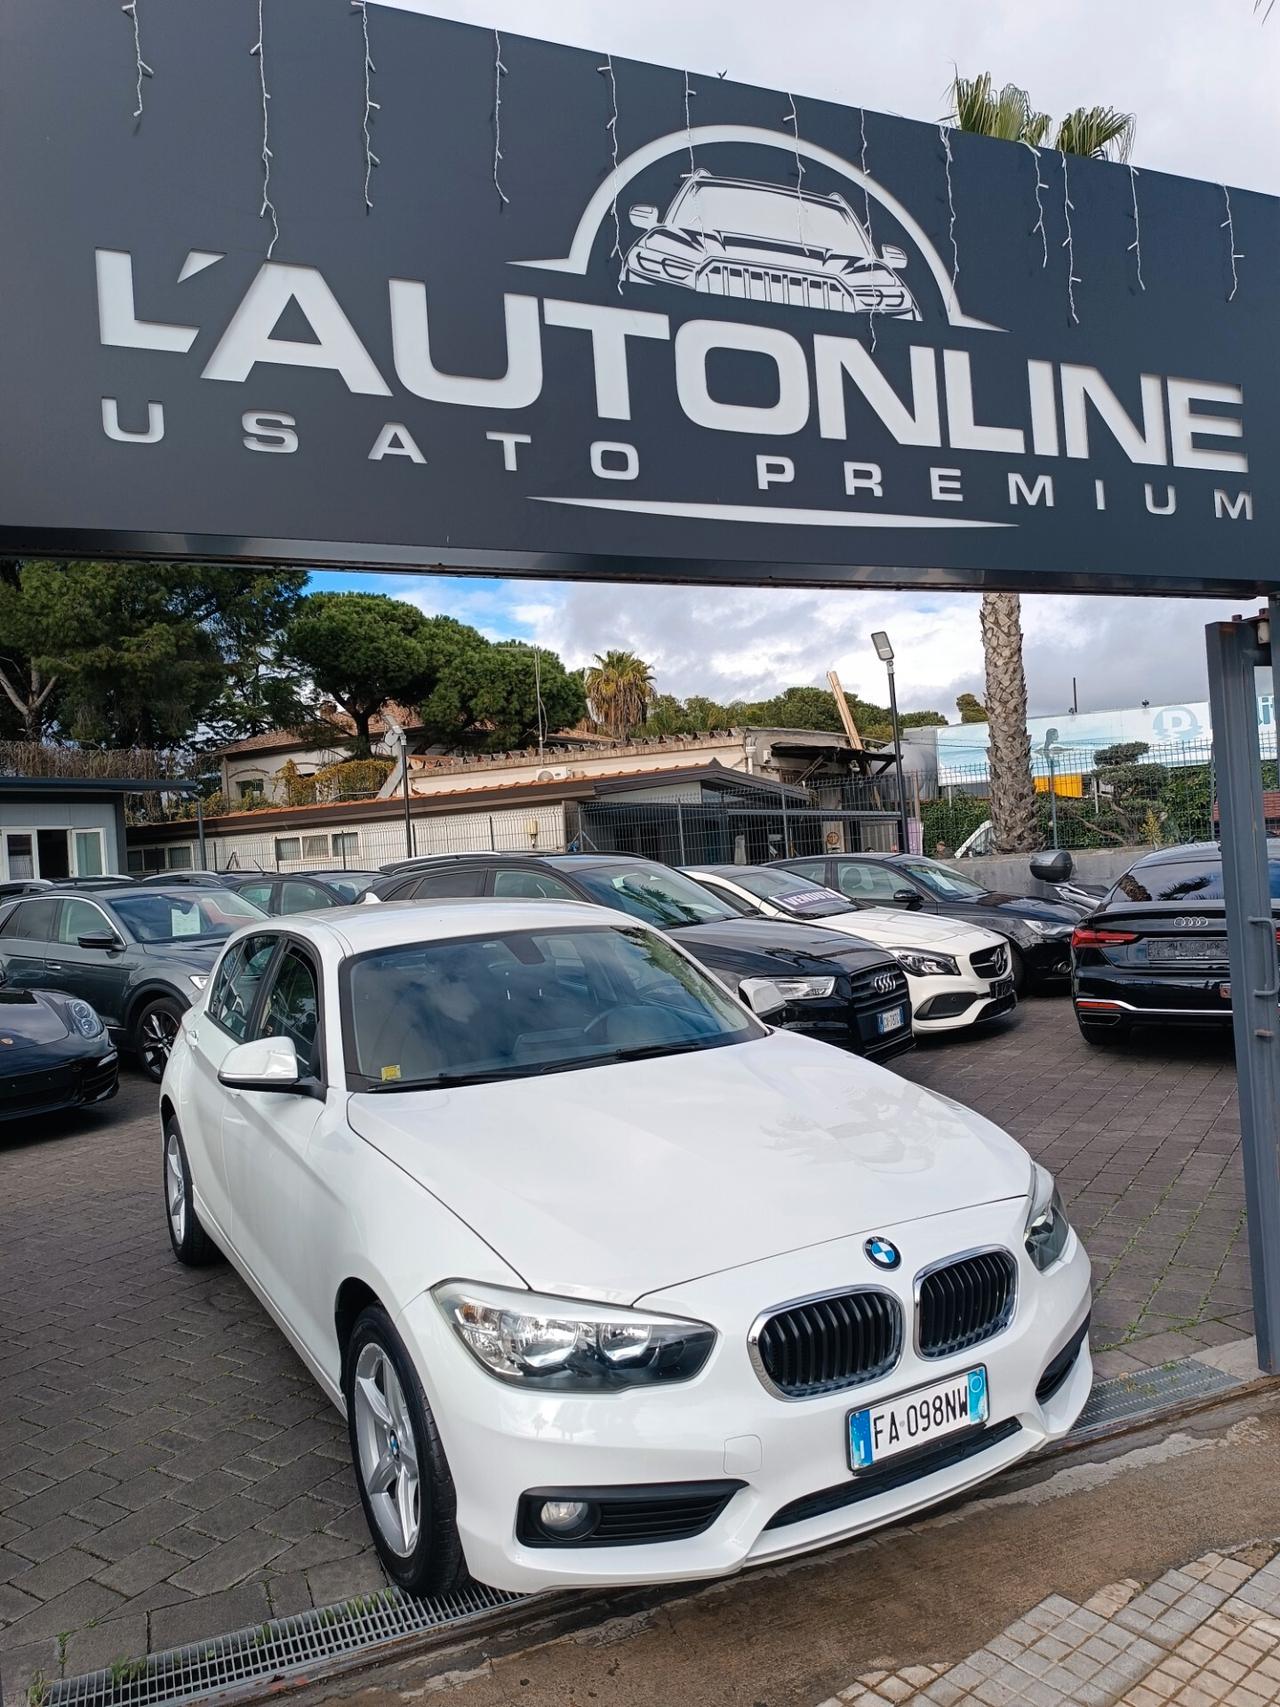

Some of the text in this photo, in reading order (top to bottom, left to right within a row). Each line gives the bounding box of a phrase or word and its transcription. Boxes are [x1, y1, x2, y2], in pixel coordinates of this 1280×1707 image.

[95, 248, 1249, 473] L'AUTONLINE
[102, 396, 1254, 521] USATO PREMIUM
[906, 1386, 968, 1437] 098NW
